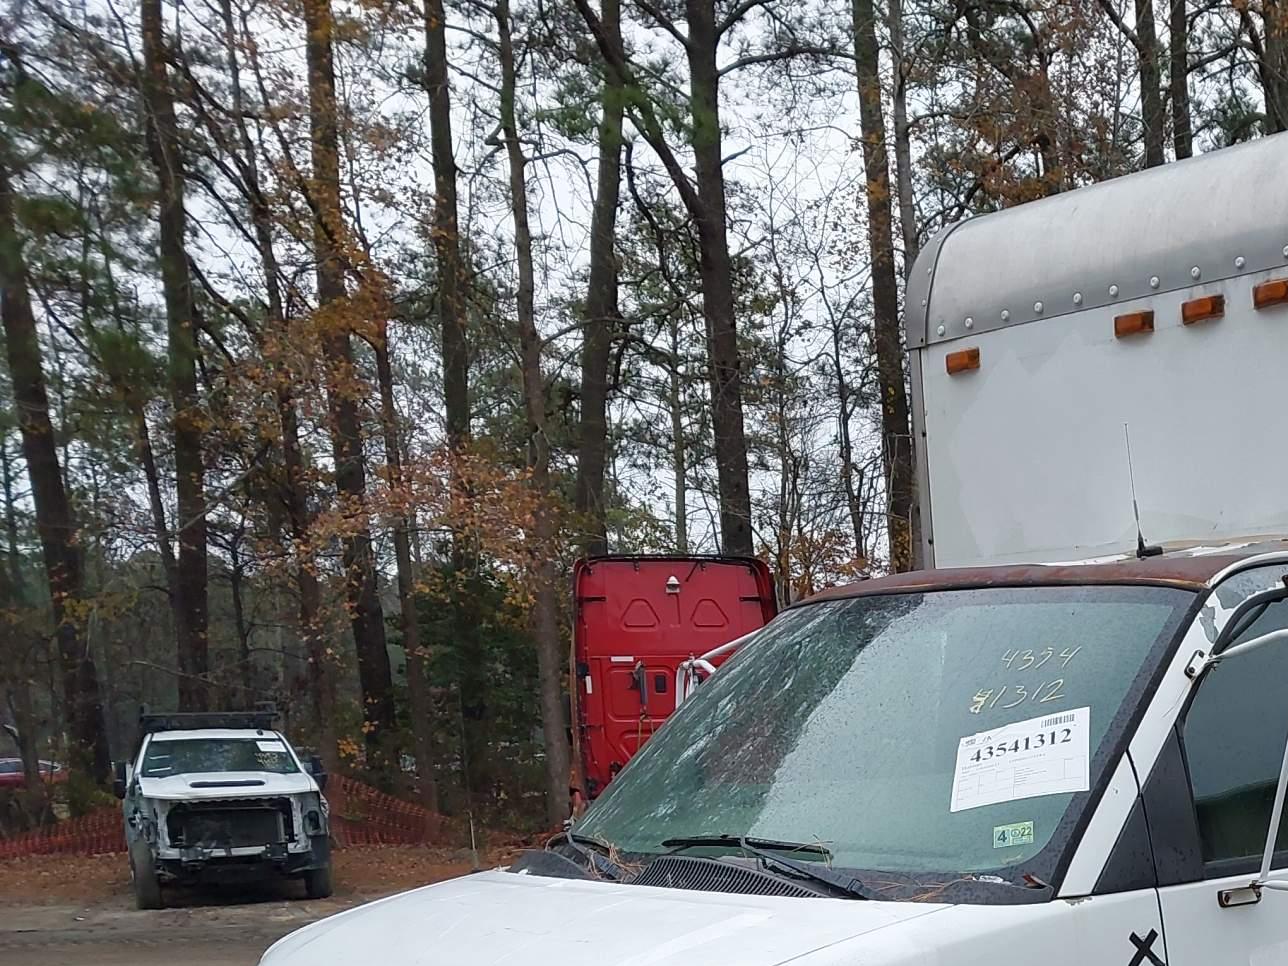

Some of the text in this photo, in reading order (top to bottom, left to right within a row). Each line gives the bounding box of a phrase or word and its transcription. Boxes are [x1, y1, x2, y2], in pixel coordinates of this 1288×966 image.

[970, 728, 1072, 762] 43541312
[997, 826, 1033, 843] 4 22
